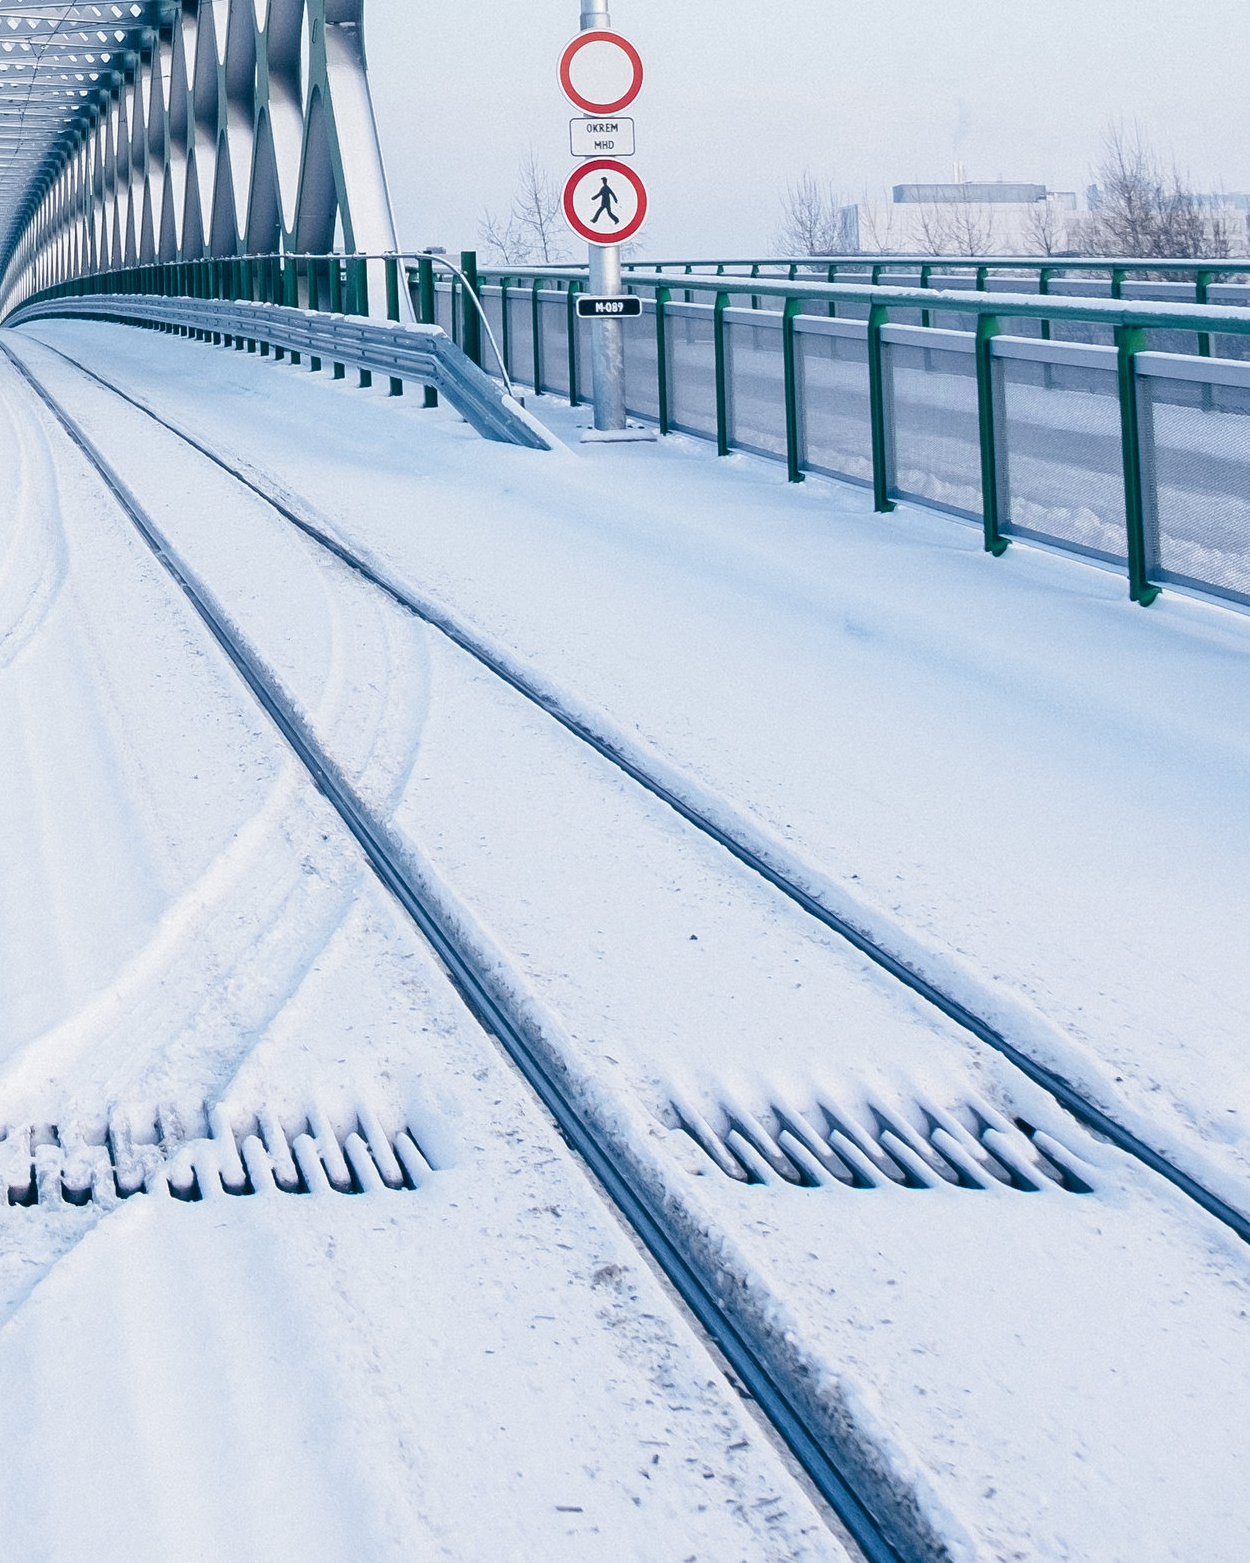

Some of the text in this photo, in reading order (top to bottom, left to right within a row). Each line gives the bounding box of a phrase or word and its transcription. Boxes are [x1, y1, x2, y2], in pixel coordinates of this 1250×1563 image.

[586, 123, 618, 133] OKREM
[594, 140, 615, 150] MHD
[595, 302, 624, 313] M-089
